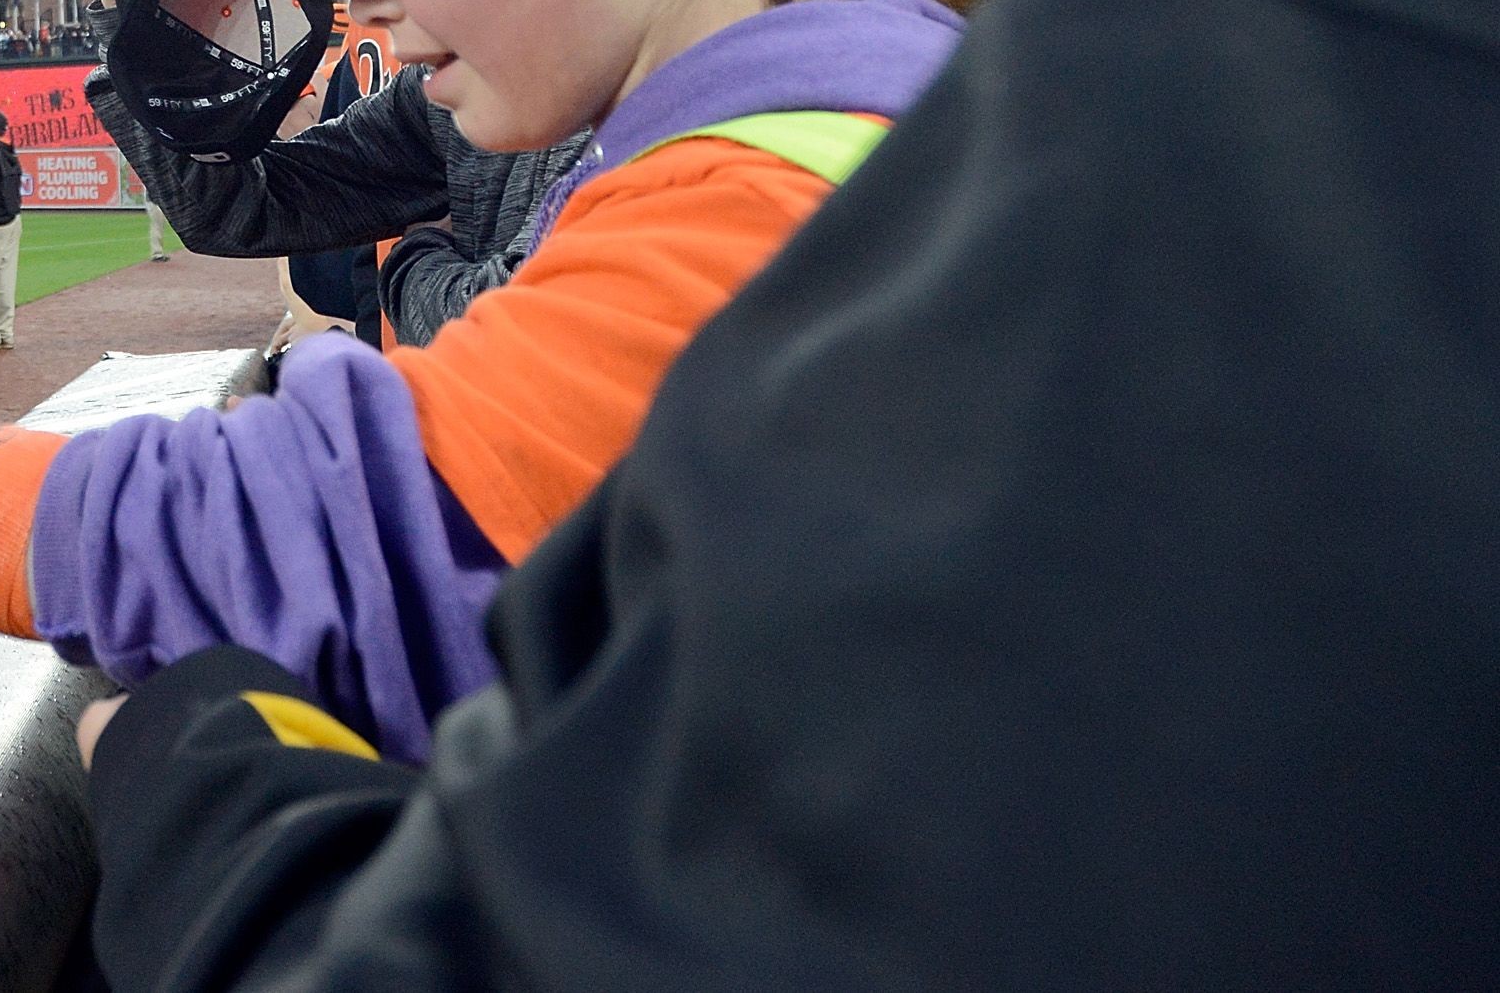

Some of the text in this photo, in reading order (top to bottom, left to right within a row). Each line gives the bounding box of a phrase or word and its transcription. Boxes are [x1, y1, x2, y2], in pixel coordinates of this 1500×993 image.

[25, 87, 75, 116] THS
[37, 156, 97, 170] HEATING
[38, 171, 109, 186] PLUMBING
[38, 186, 99, 200] COOLING
